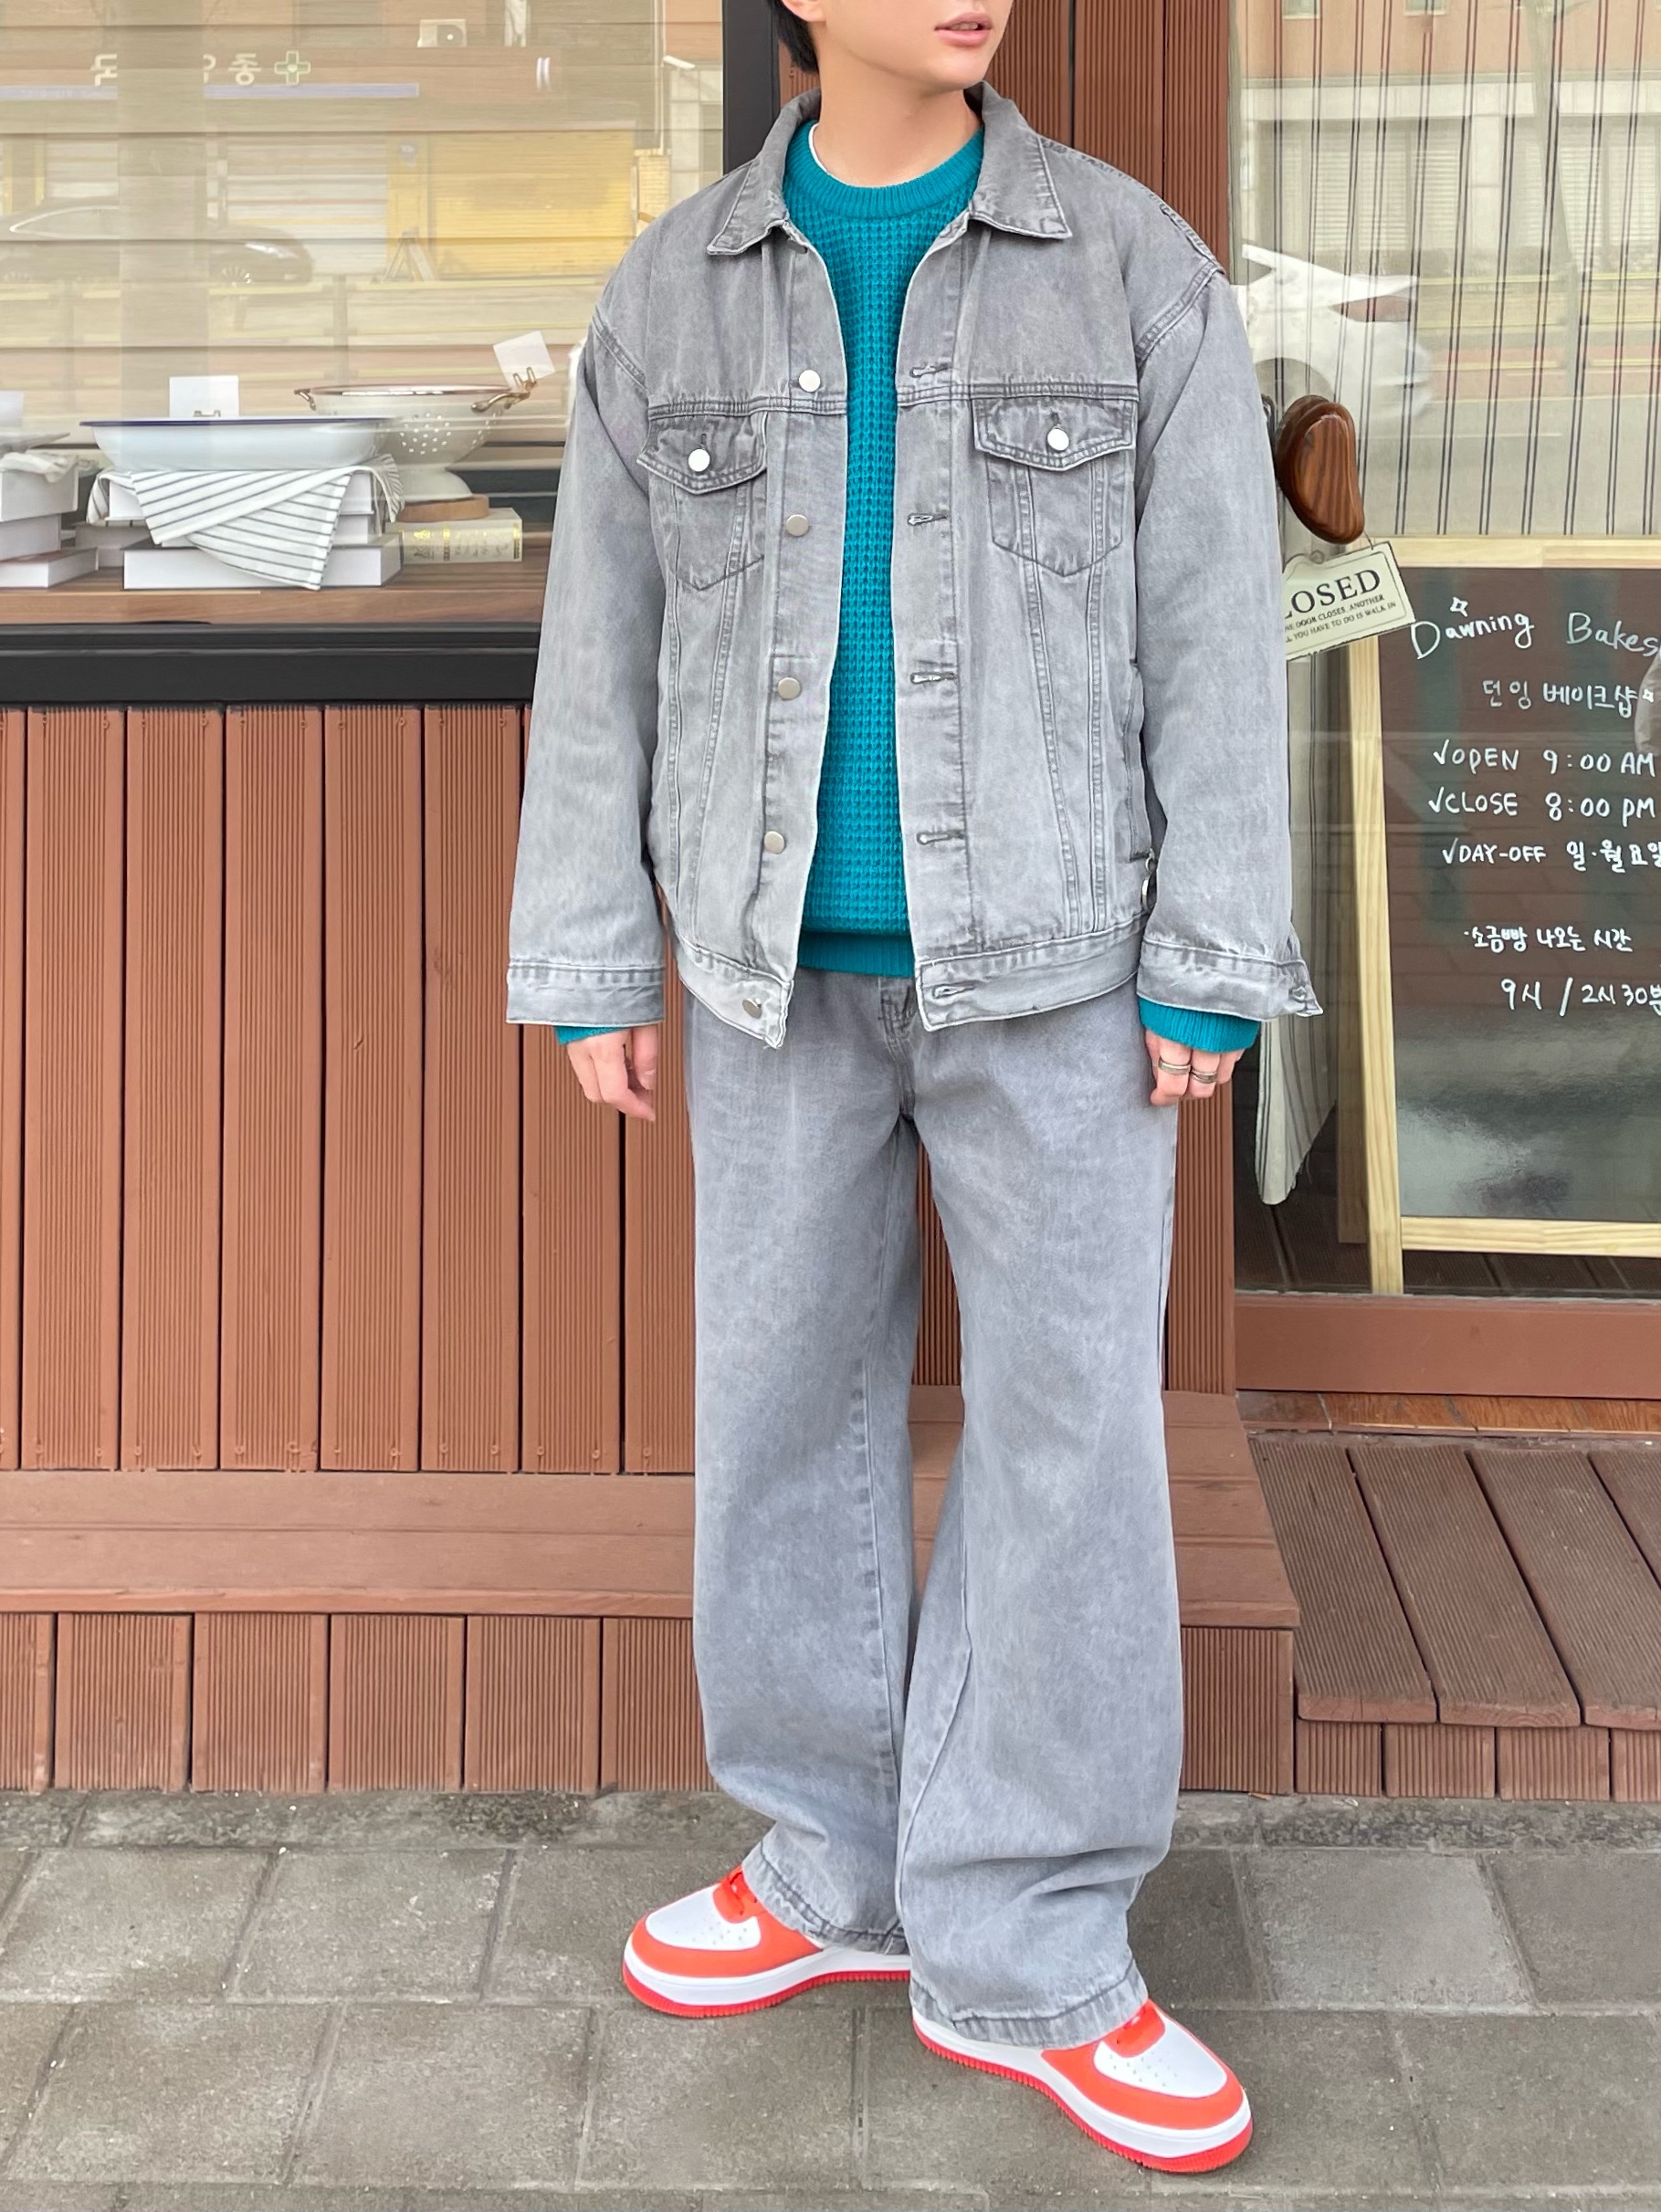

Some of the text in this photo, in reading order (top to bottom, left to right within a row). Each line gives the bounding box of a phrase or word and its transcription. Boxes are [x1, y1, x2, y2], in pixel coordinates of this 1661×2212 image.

[1285, 569, 1381, 620] OSED
[1297, 615, 1318, 629] DOOR
[1349, 593, 1385, 612] ANOTHER
[1293, 630, 1309, 641] YOU
[1310, 623, 1330, 635] HAVE
[1332, 618, 1342, 627] TO
[1343, 614, 1355, 624] DO
[1356, 612, 1364, 620] IS
[1364, 606, 1386, 617] WALK
[1387, 601, 1397, 611] IN
[1410, 611, 1661, 659] Dawning Bakes
[1542, 682, 1639, 718] 베이크샵
[1451, 748, 1656, 777] OPEN 9:00 AM
[1445, 791, 1519, 816] CLOSE
[1545, 792, 1611, 822] 8:00
[1459, 843, 1547, 864] DAY-OFF
[1536, 926, 1586, 952] 나오는
[1593, 928, 1634, 952] 시간
[1500, 978, 1542, 1011] 9시
[1581, 984, 1616, 1005] 2시
